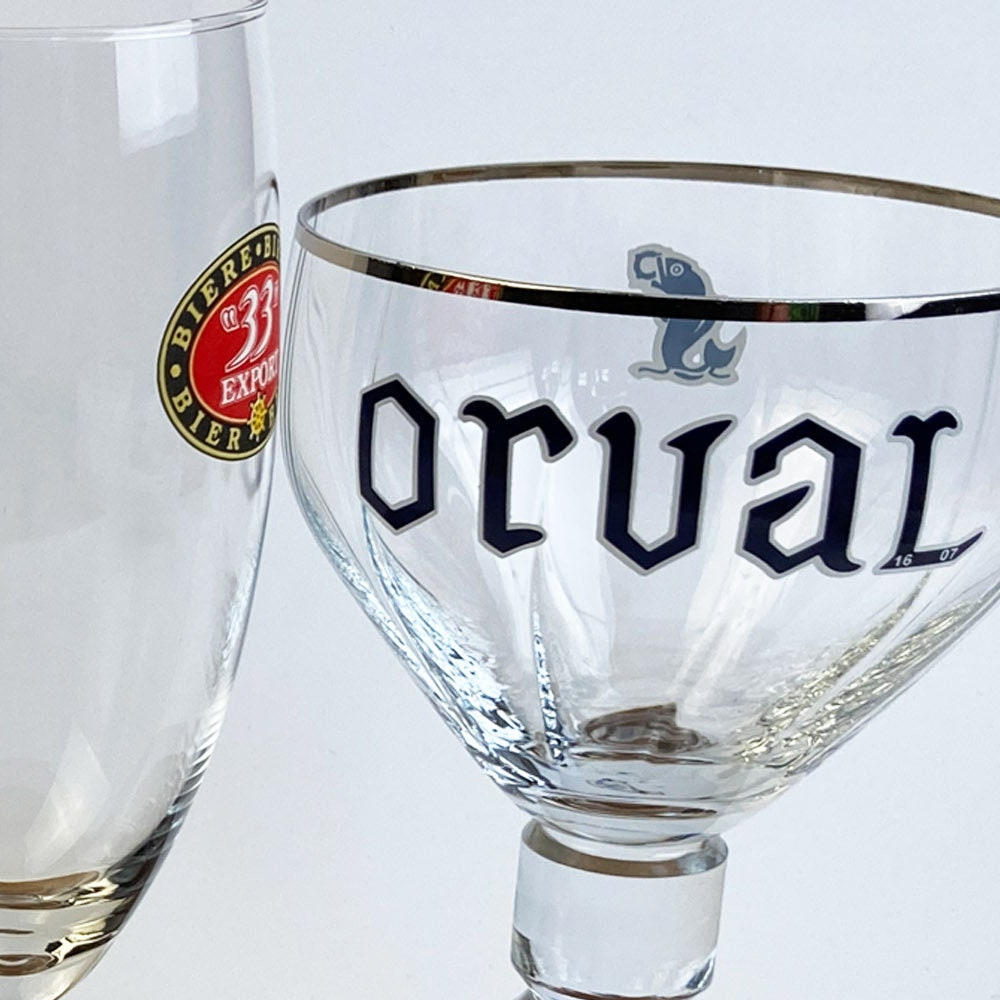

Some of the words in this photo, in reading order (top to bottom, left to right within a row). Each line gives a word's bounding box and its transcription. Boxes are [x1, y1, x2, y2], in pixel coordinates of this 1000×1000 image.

[171, 245, 253, 352] BIERE
[172, 386, 242, 451] BIER
[894, 554, 914, 567] 16
[939, 547, 959, 561] 07
